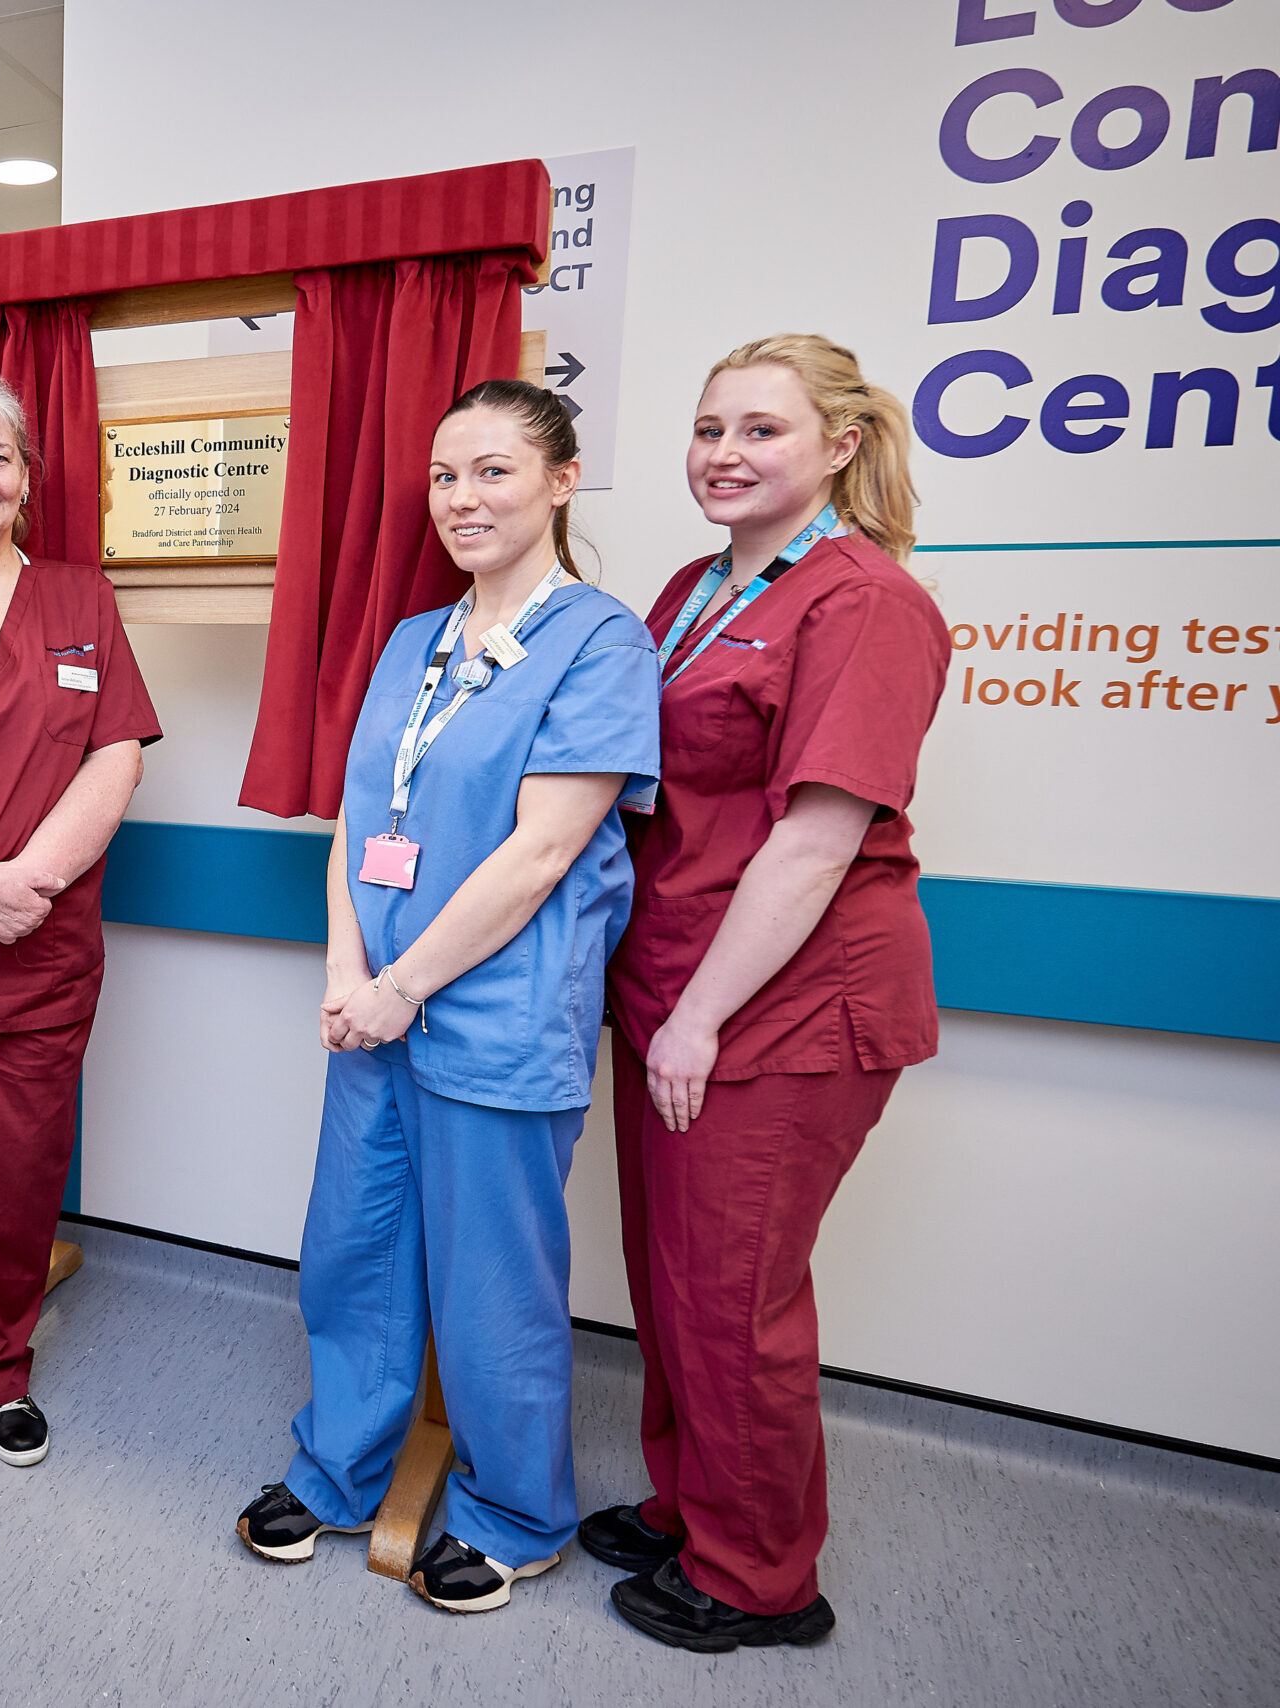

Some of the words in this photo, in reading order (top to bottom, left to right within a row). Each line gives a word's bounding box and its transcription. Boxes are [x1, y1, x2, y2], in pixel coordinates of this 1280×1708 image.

[522, 262, 593, 295] CT
[927, 200, 1280, 334] Diag
[114, 439, 185, 458] Eccleshill
[190, 434, 287, 453] Community
[128, 463, 209, 484] Diagnostic
[214, 461, 269, 477] Centre
[148, 488, 192, 501] officially
[194, 487, 230, 500] opened
[232, 488, 246, 497] on
[153, 506, 166, 516] 27
[168, 505, 212, 517] February
[215, 503, 240, 514] 2024
[132, 529, 164, 538] Bradford
[165, 528, 192, 537] District
[193, 528, 207, 536] and
[208, 527, 236, 536] Craven
[237, 526, 263, 535] Health
[158, 539, 172, 548] and
[172, 539, 191, 548] Care
[192, 538, 234, 548] Partnership
[676, 588, 709, 629] BTHFT
[948, 613, 1160, 664] oviding
[961, 667, 1082, 708] look
[1101, 669, 1247, 712] after
